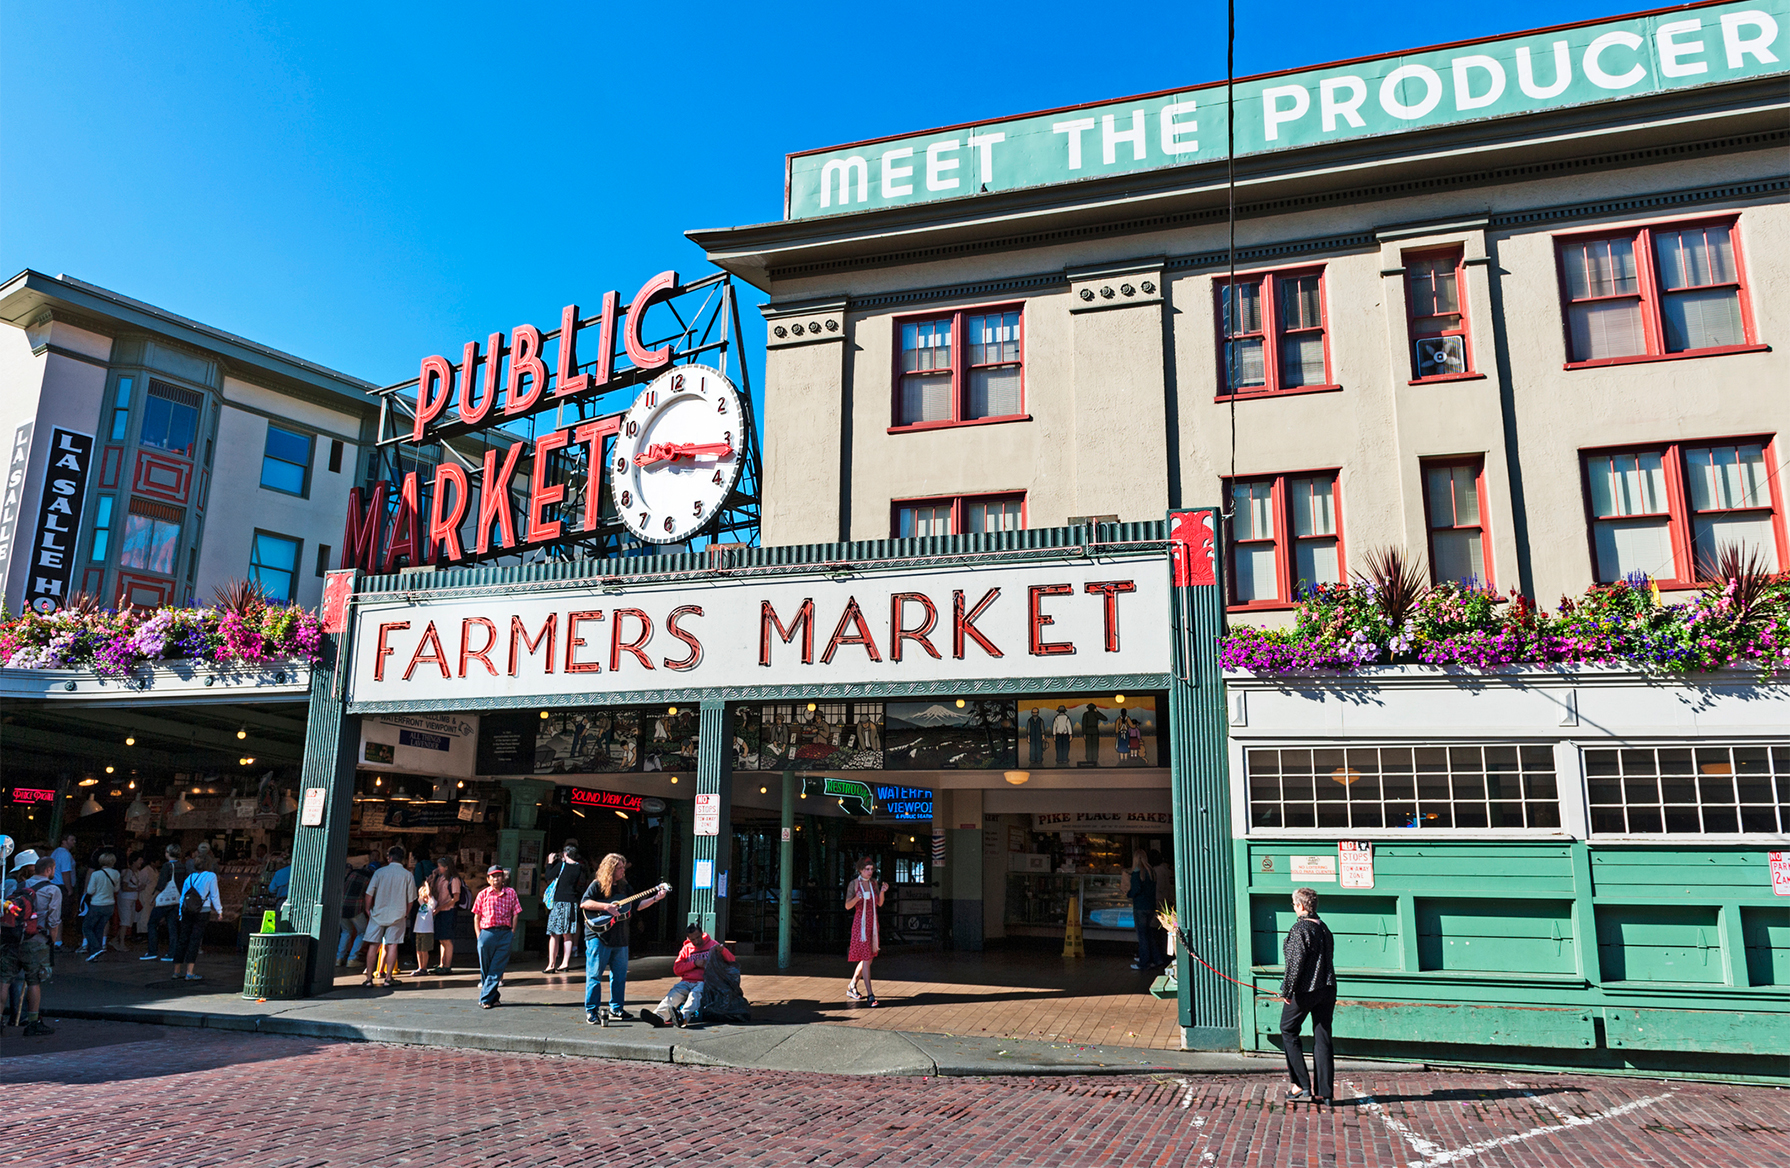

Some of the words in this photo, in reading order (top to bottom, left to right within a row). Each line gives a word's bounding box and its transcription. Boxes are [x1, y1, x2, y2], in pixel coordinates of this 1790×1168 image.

[819, 131, 1006, 208] MEET
[1052, 100, 1199, 170] THE
[1261, 10, 1780, 142] PRODUCER
[412, 270, 679, 442] PUBLIC
[671, 374, 684, 392] 12
[701, 377, 707, 393] 1
[646, 390, 657, 409] 11
[717, 397, 727, 414] 2
[626, 420, 638, 438] 10
[724, 431, 733, 445] 3
[55, 433, 83, 472] LA
[617, 457, 628, 474] 9
[712, 469, 724, 486] 4
[341, 416, 629, 575] MARKET
[621, 490, 631, 507] 8
[693, 501, 704, 517] 5
[38, 479, 77, 569] SALLE
[639, 512, 650, 529] 7
[664, 516, 675, 532] 6
[373, 604, 705, 682] FARMERS
[758, 579, 1138, 667] MARKET
[381, 714, 423, 727] WATERFRONT
[425, 721, 457, 733] VIEWPOINT
[571, 788, 600, 803] SOUND
[602, 791, 622, 805] VIEW
[827, 780, 872, 807] RESTROOMS
[698, 805, 717, 813] STOPS
[1038, 813, 1071, 825] PIKE
[1076, 812, 1121, 821] PLACE
[1343, 853, 1369, 861] STOPS
[1770, 852, 1781, 861] NO
